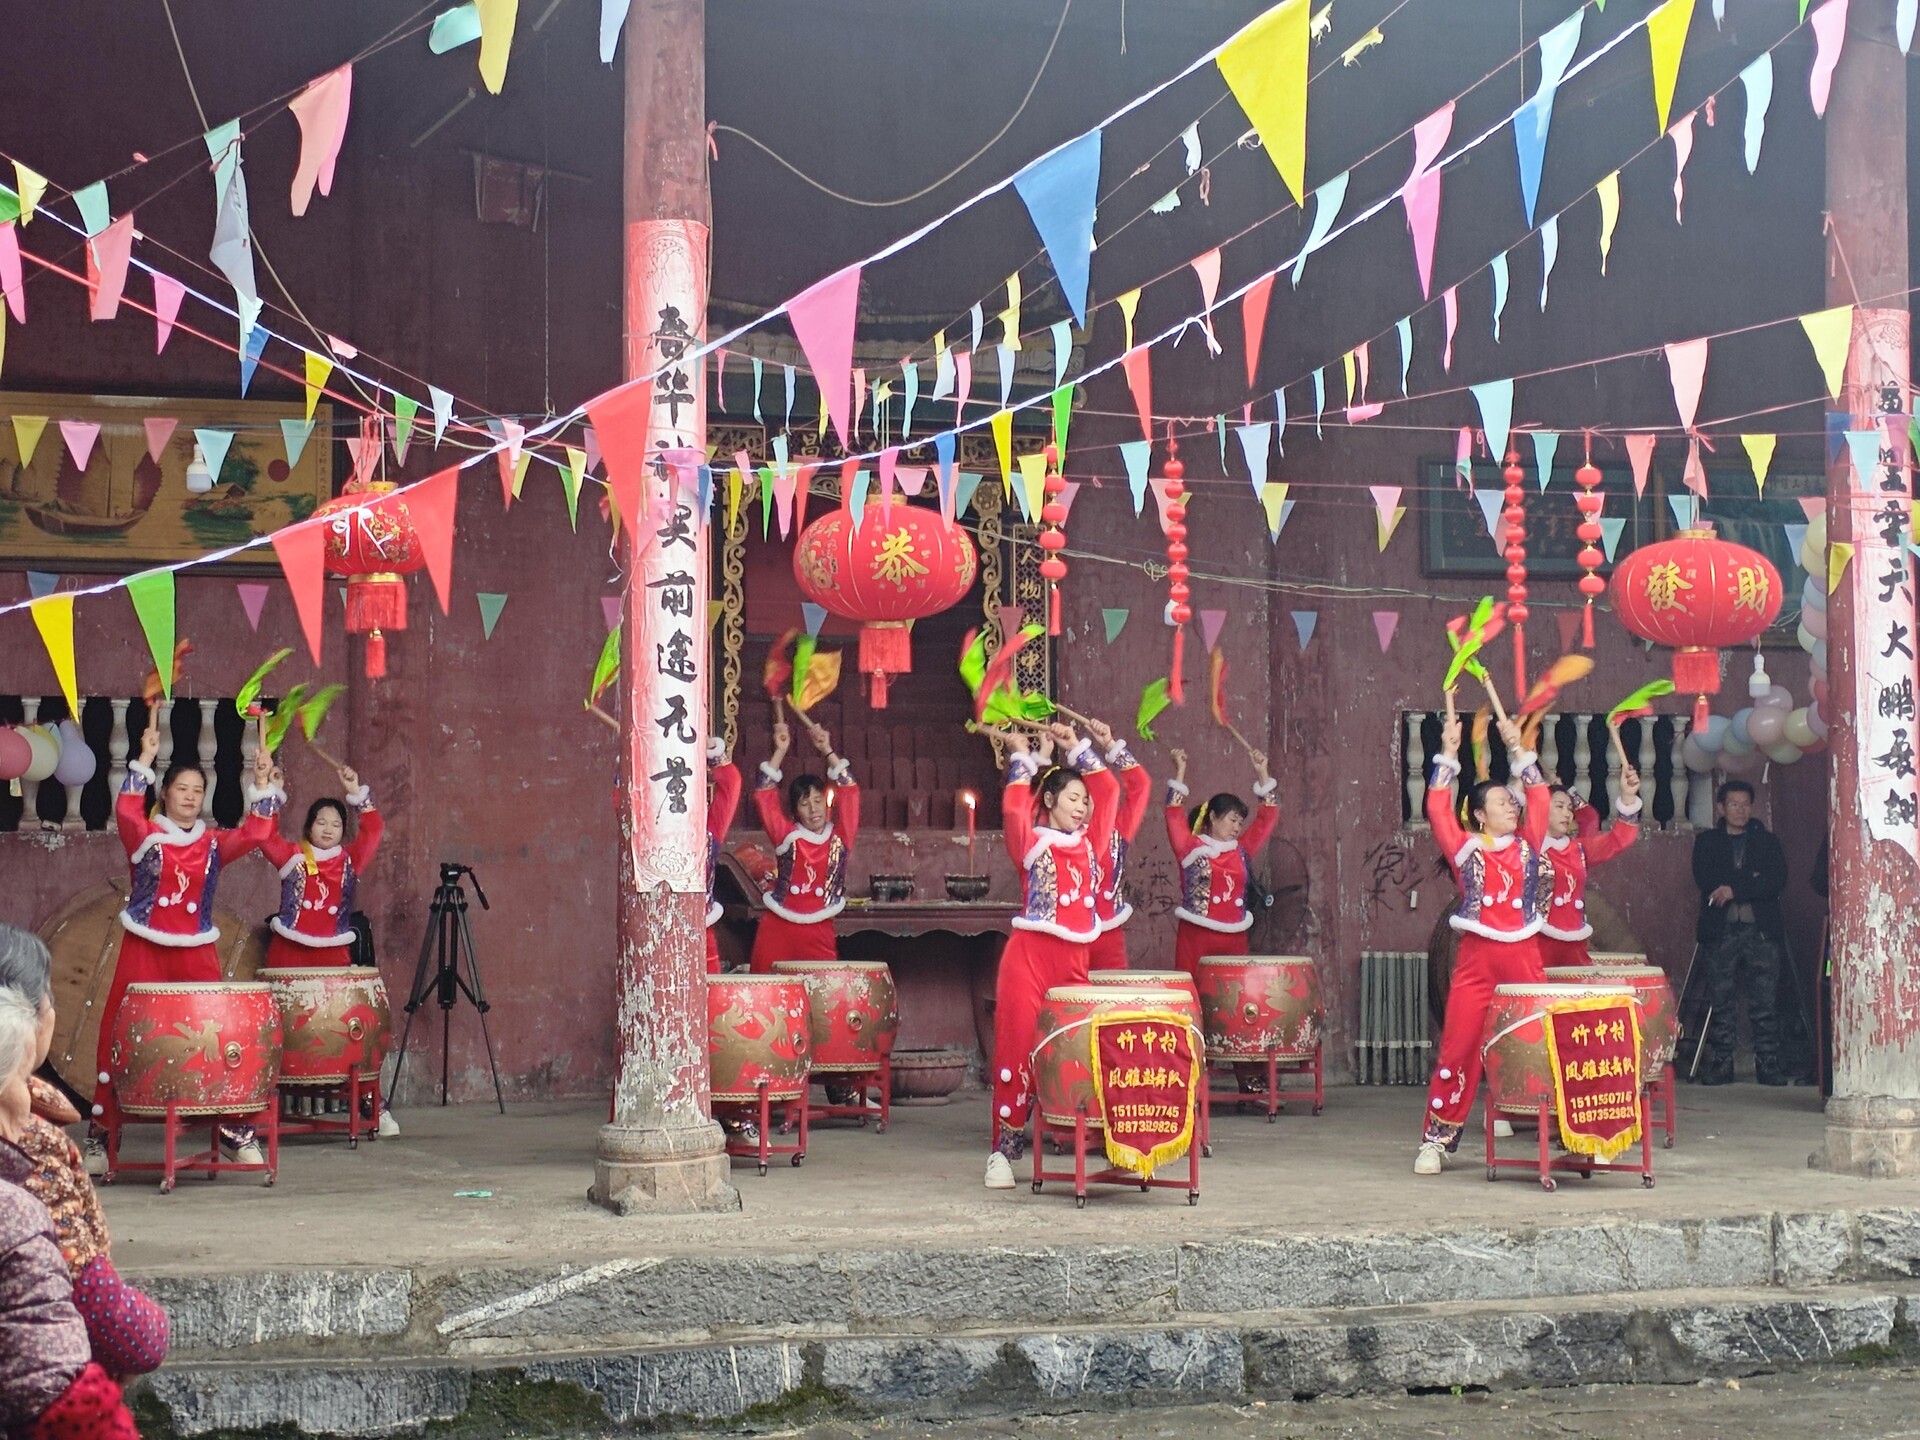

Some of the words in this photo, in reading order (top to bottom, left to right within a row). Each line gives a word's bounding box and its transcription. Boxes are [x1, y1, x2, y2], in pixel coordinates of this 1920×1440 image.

[1116, 1026, 1178, 1054] 竹中村
[1571, 1018, 1625, 1046] 竹中村
